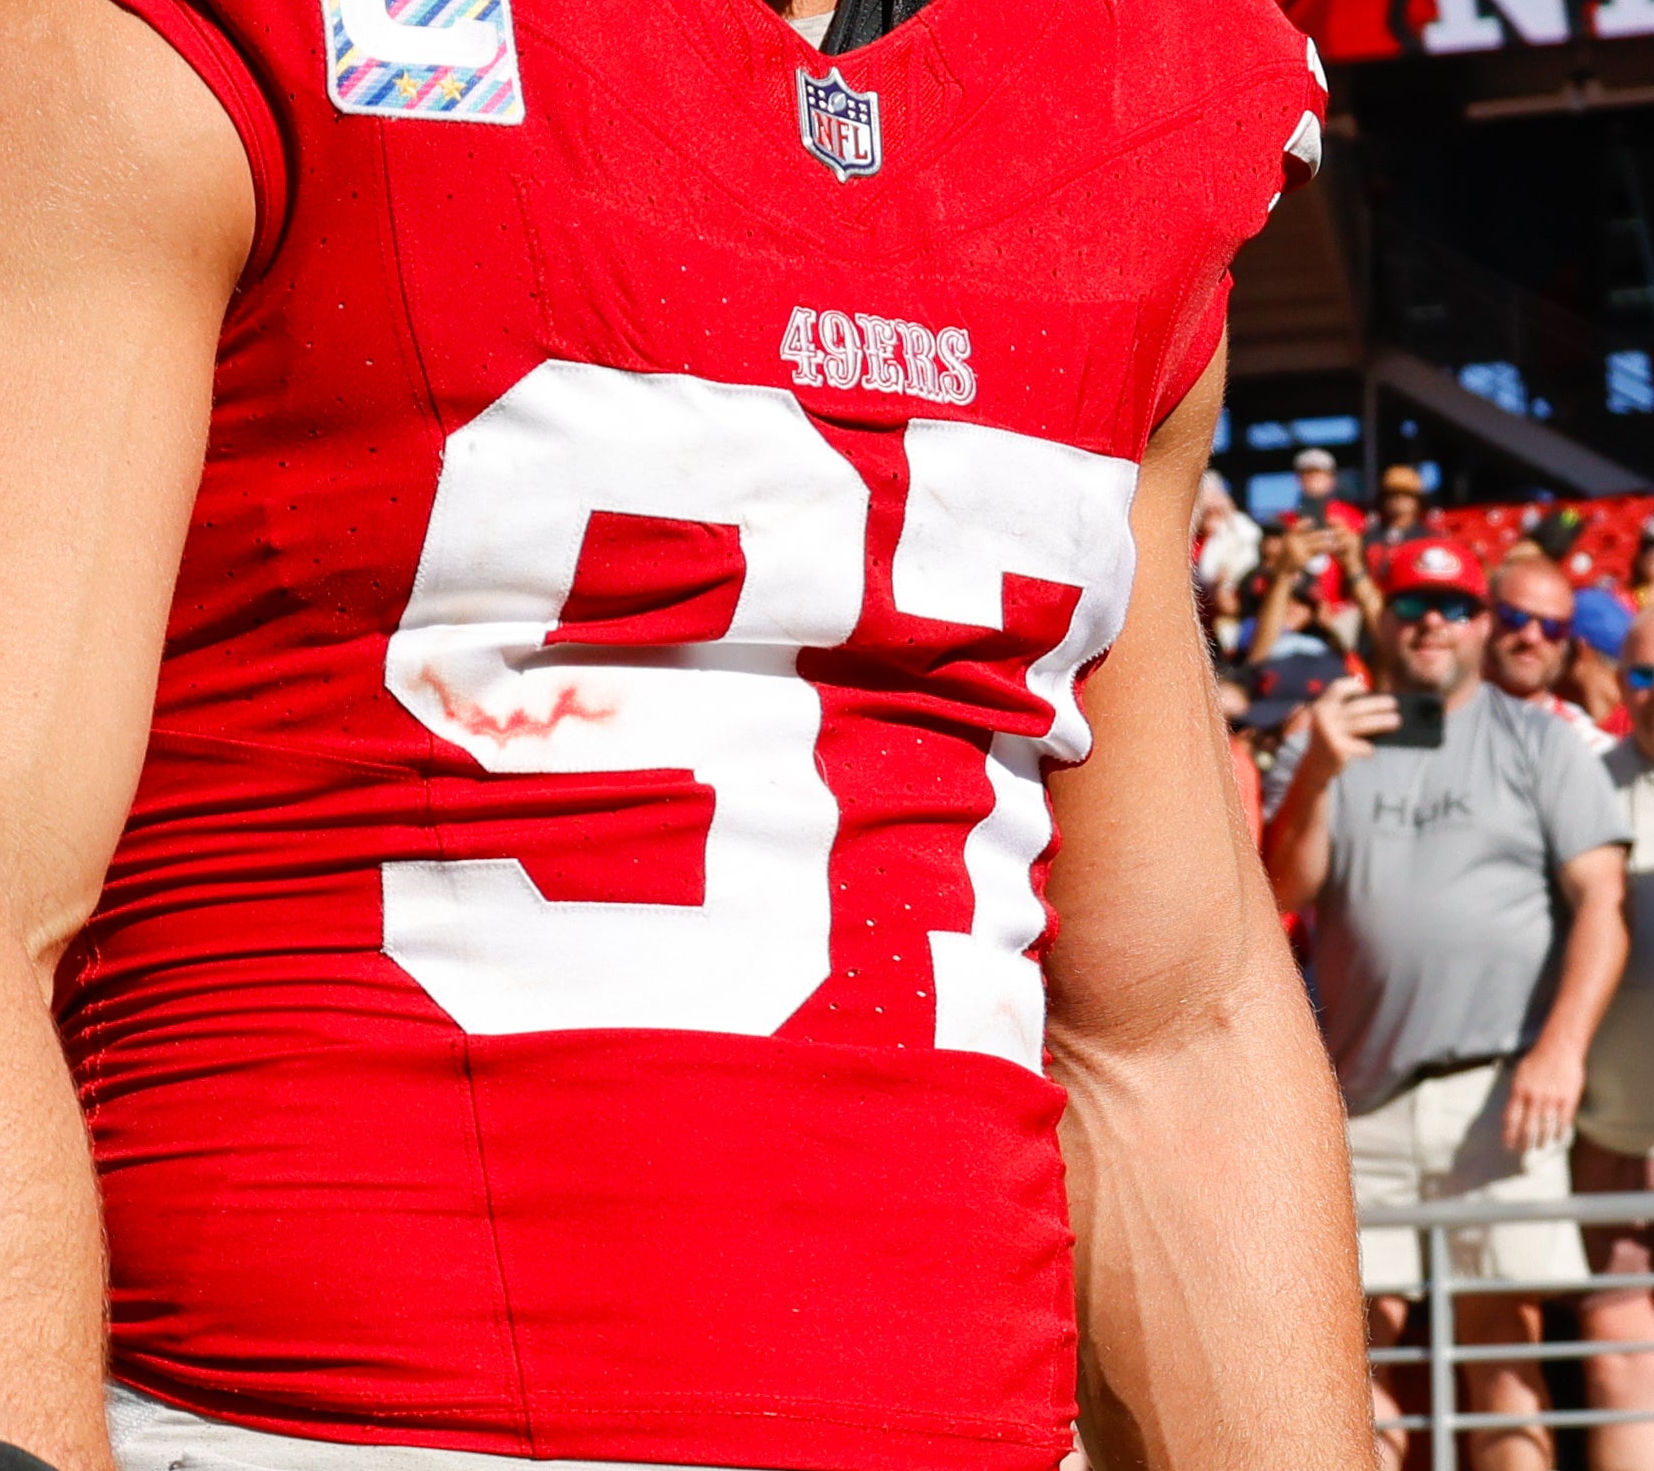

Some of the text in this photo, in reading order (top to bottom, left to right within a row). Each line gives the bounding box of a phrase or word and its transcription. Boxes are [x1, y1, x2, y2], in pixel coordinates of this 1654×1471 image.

[812, 112, 869, 163] NFL
[780, 305, 977, 406] 49ERS
[380, 358, 1139, 1077] 97
